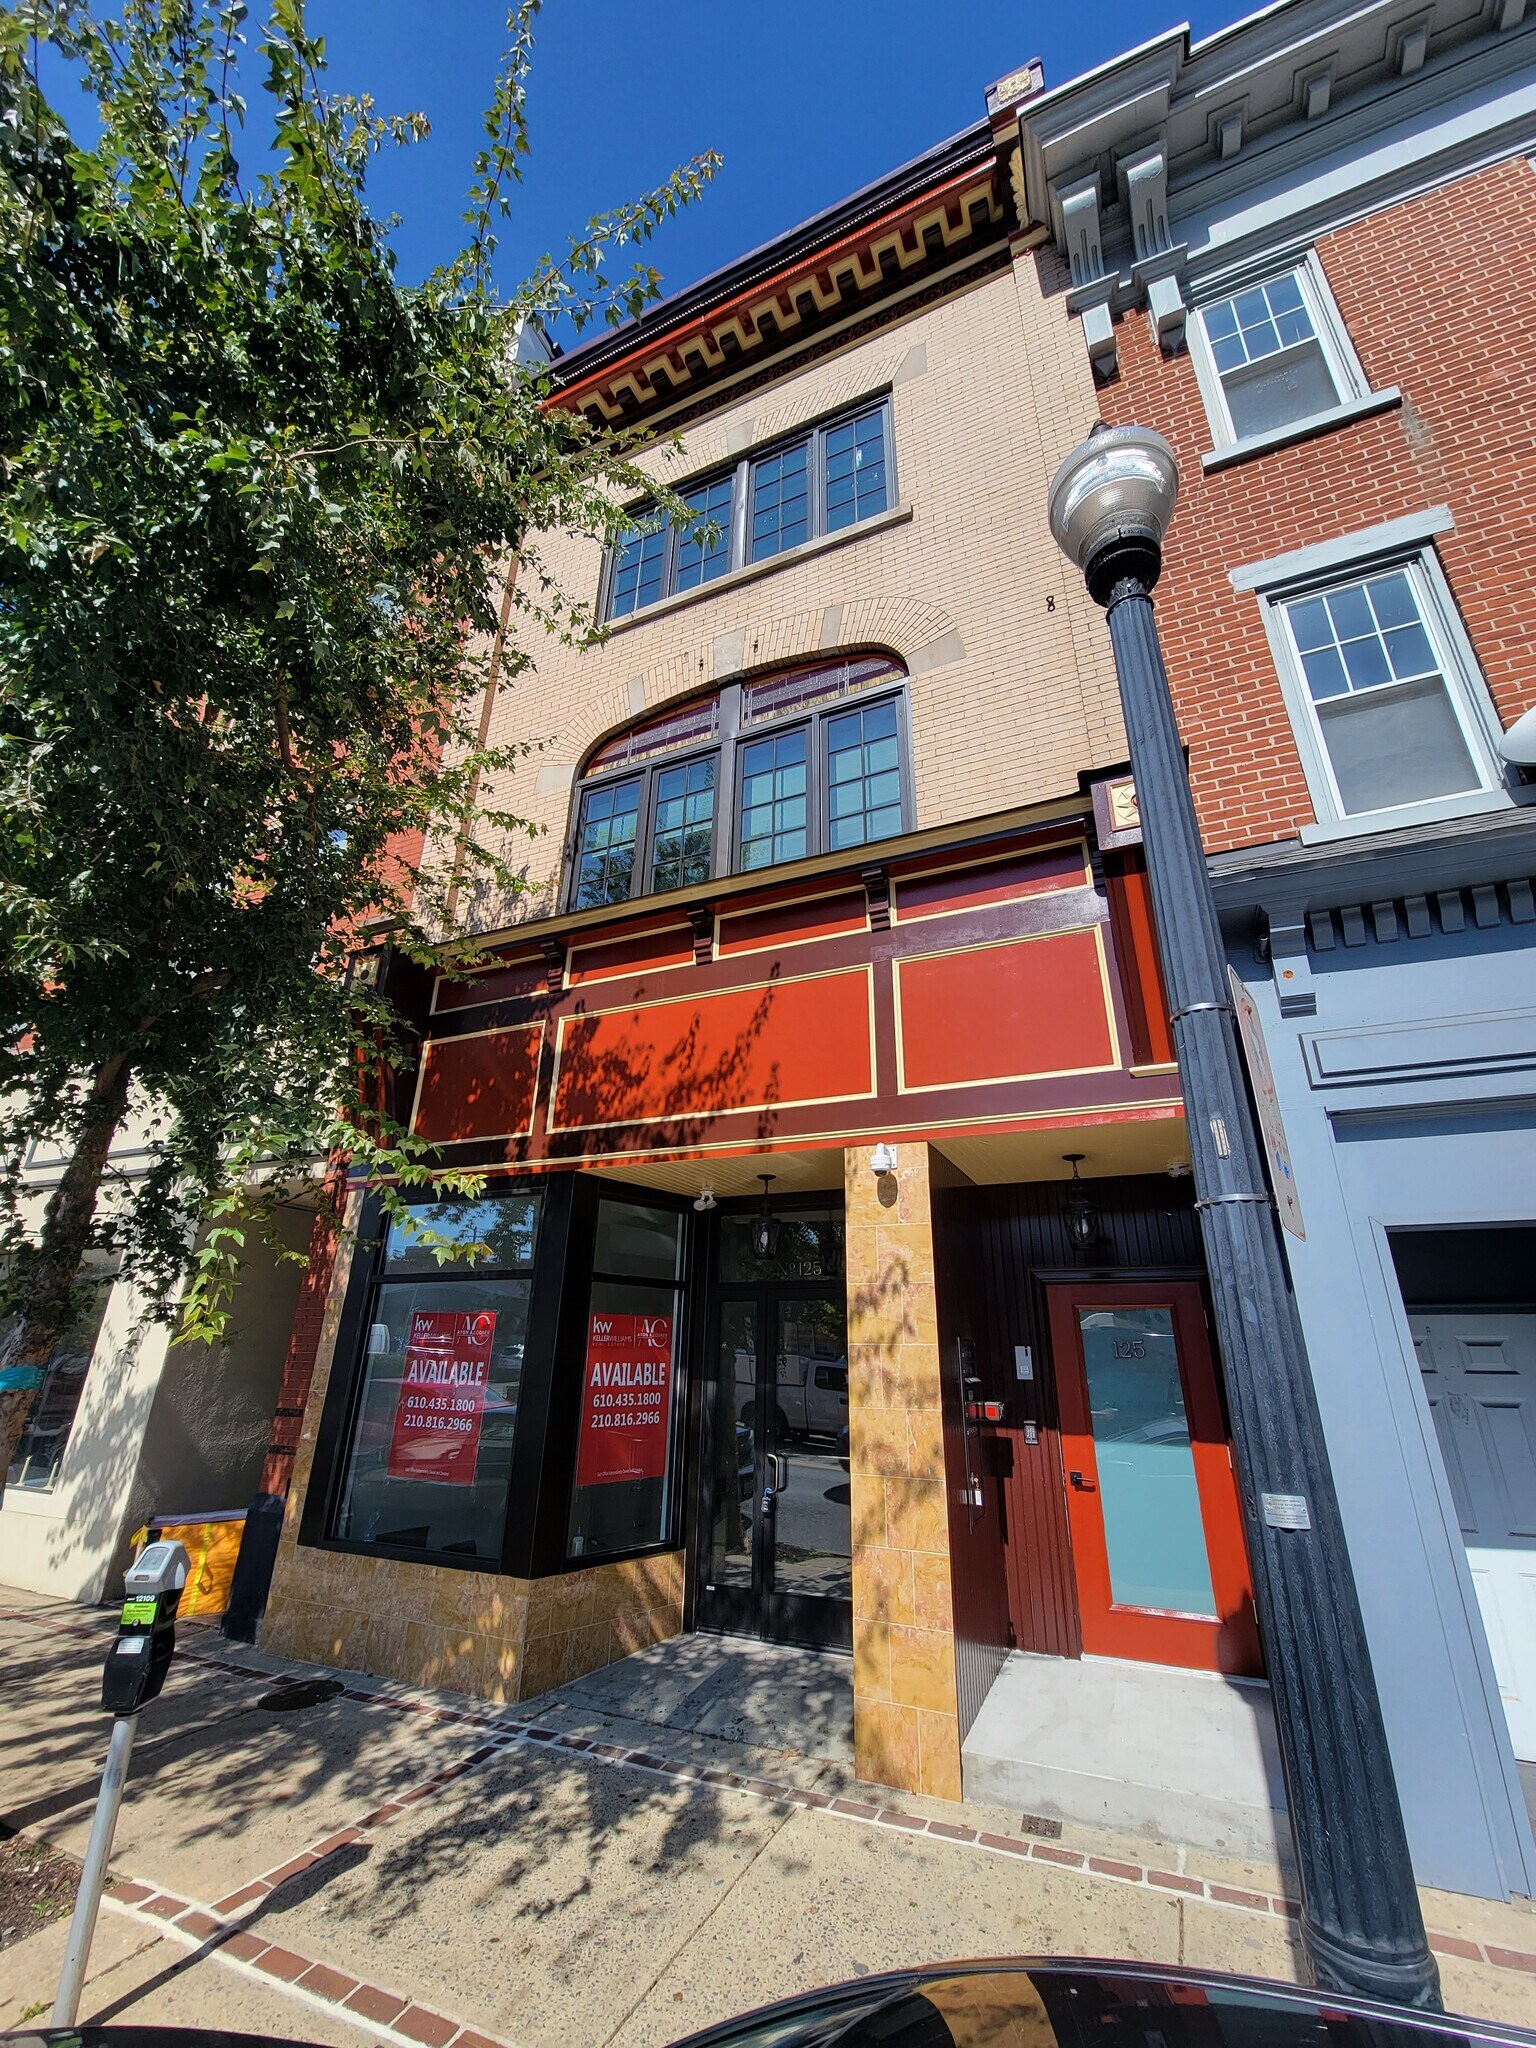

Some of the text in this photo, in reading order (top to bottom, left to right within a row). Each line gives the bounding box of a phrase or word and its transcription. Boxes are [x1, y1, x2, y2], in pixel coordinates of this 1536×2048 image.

[593, 1316, 613, 1334] kw
[1113, 1340, 1146, 1358] 125
[407, 1360, 484, 1386] AVAILABLE
[590, 1362, 666, 1387] AVAILABLE
[407, 1396, 475, 1413] 610.435.1800
[593, 1392, 661, 1408] 610.435.1800
[403, 1414, 473, 1431] 210.816.2966
[591, 1411, 660, 1429] 210.816.2966
